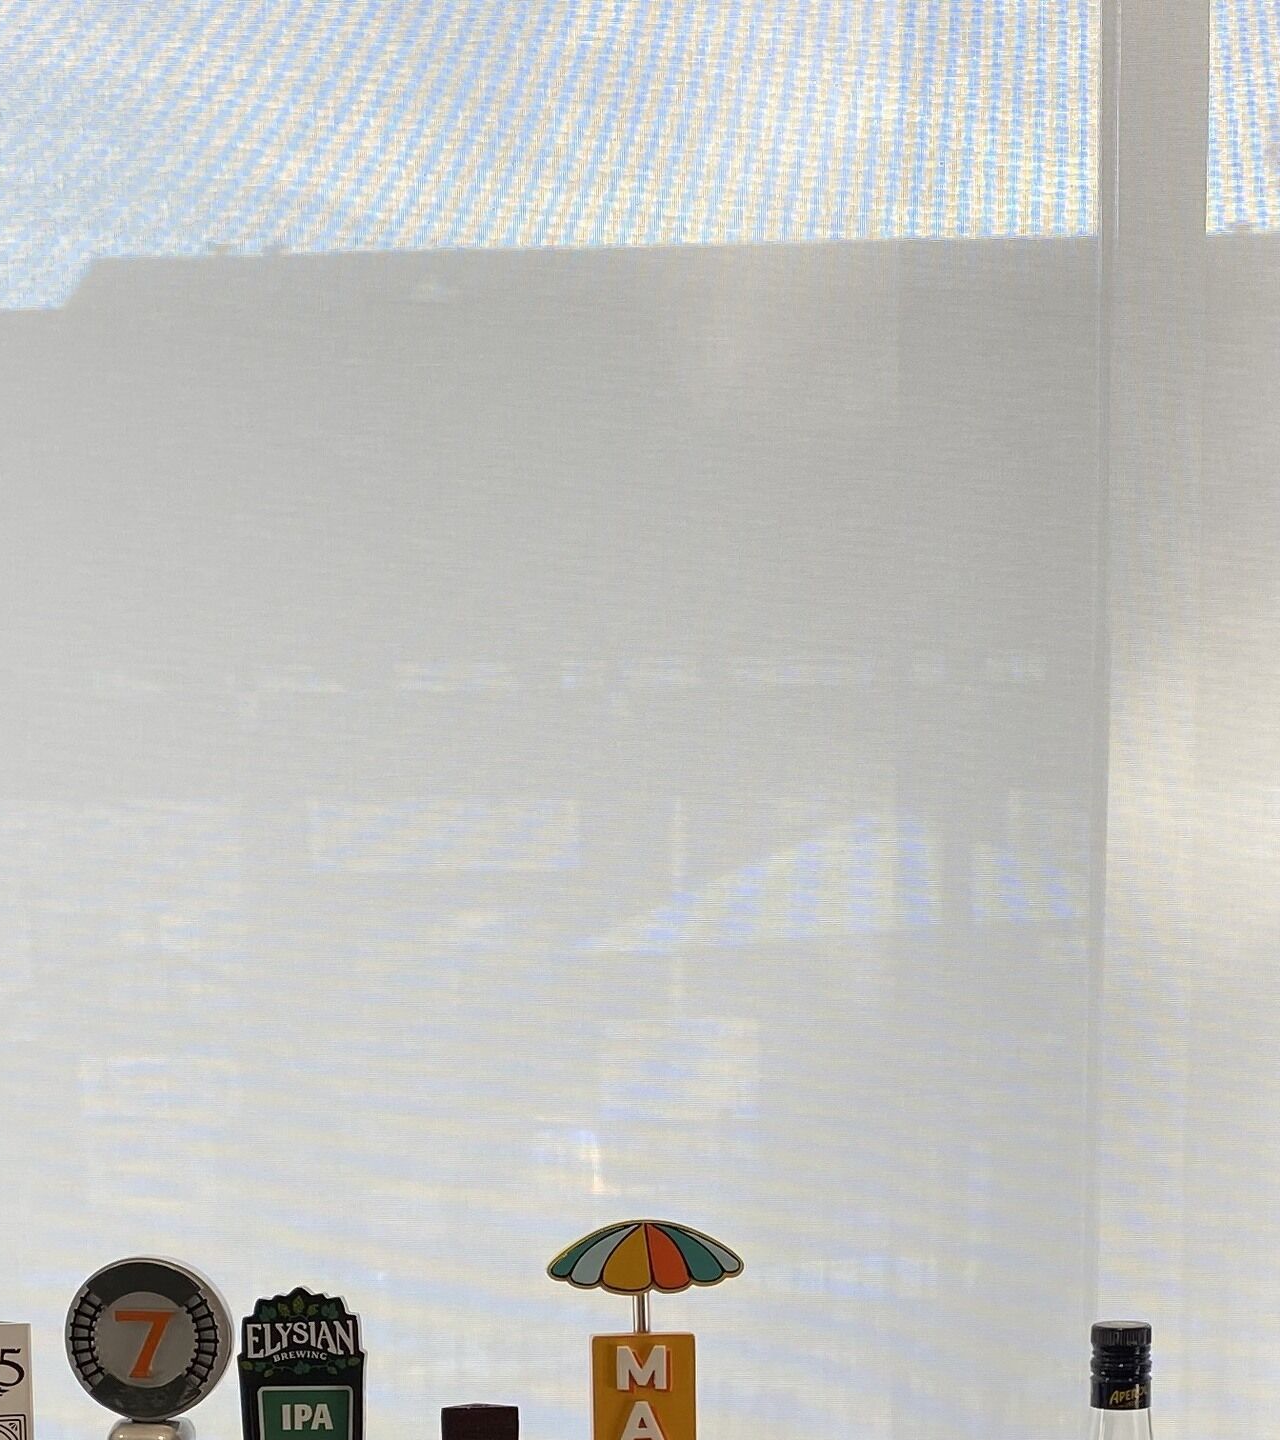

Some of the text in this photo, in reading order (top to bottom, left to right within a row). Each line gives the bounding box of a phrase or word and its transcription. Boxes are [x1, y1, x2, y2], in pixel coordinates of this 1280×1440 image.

[114, 1310, 176, 1379] 7
[246, 1320, 355, 1360] ELYSIAN
[272, 1350, 327, 1363] BREWING
[281, 1403, 334, 1431] IPA
